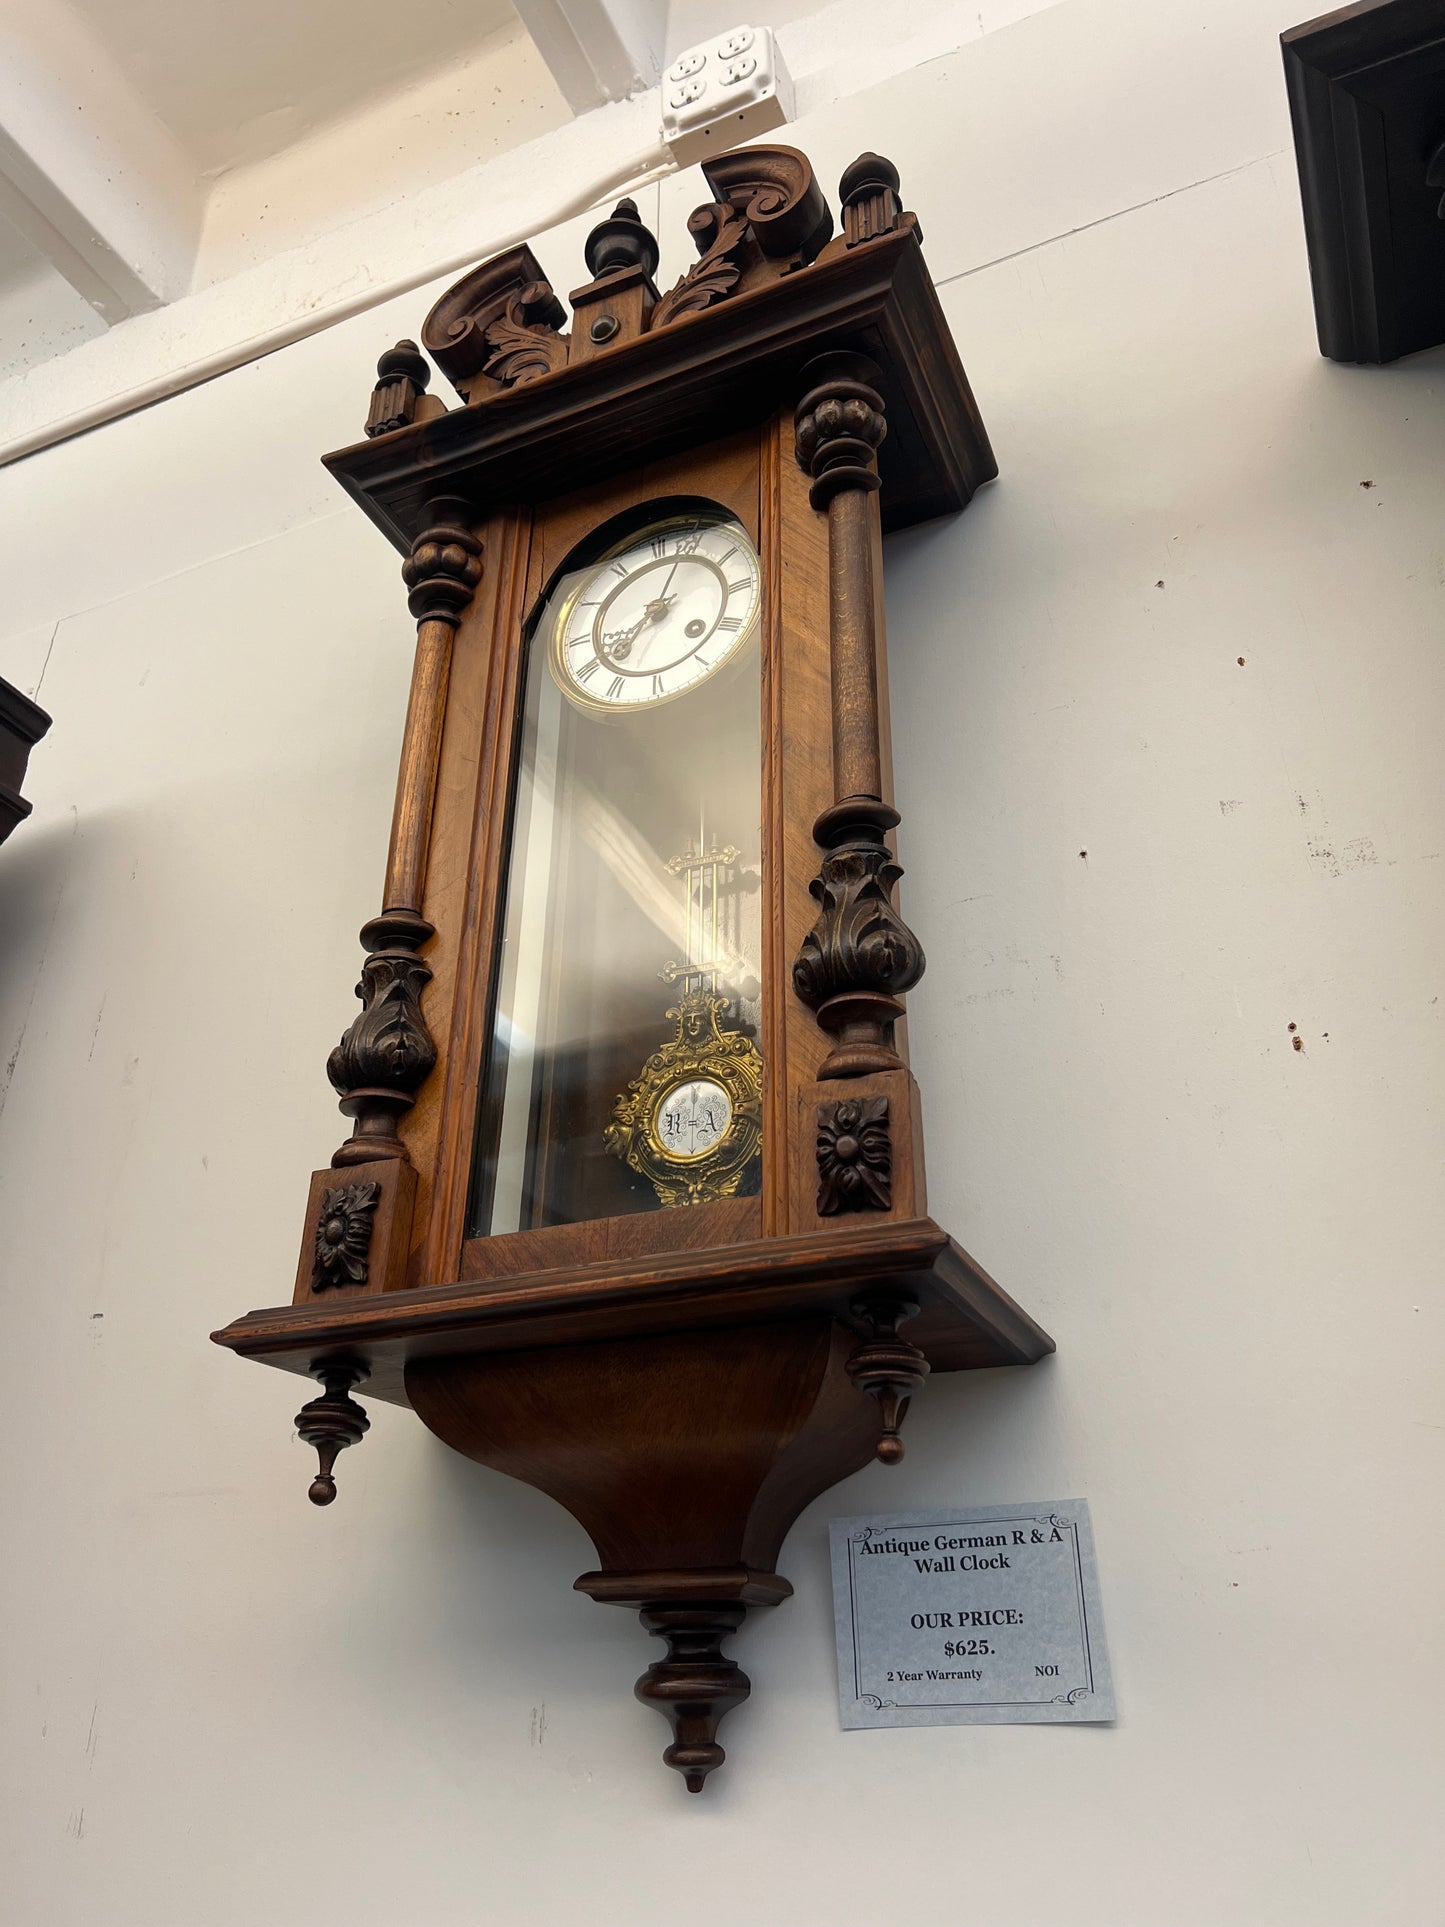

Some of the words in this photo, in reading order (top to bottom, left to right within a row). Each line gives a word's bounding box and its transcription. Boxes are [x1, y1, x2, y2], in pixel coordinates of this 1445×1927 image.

[716, 546, 738, 567] II
[728, 577, 752, 595] III
[717, 616, 743, 632] IIII
[606, 676, 626, 699] VII
[860, 1540, 930, 1557] Antique
[934, 1532, 1007, 1550] German
[1012, 1530, 1026, 1545] R
[1030, 1529, 1044, 1544] &
[1049, 1527, 1063, 1543] A
[914, 1556, 955, 1573] Wall
[960, 1553, 1011, 1571] Clock
[910, 1613, 954, 1629] OUR
[958, 1609, 1024, 1627] PRICE:
[944, 1639, 995, 1658] $625.
[887, 1671, 894, 1682] 2
[896, 1670, 924, 1681] Year
[926, 1668, 983, 1681] Warranty
